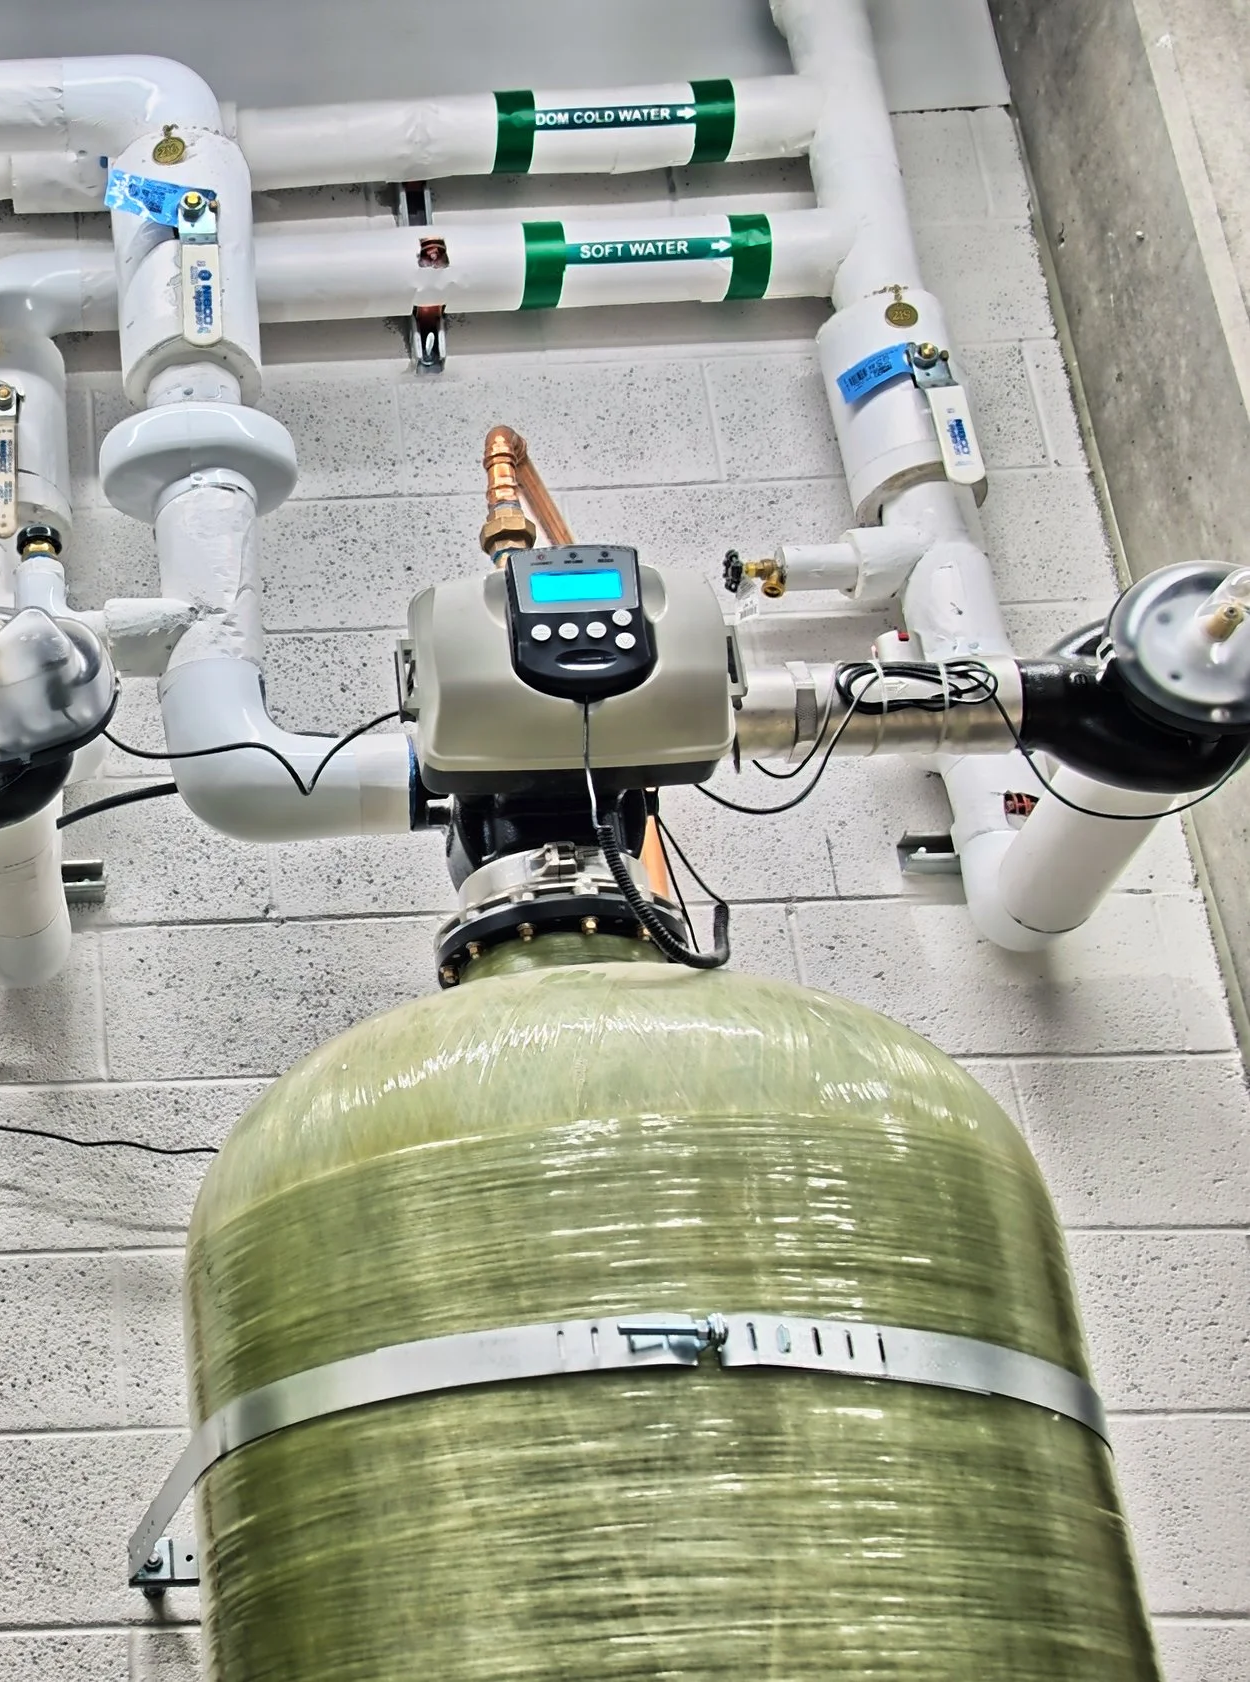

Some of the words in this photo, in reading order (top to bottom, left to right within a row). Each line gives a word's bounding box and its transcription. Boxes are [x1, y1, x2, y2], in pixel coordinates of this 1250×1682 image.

[535, 112, 569, 126] DOM
[573, 110, 614, 124] COLD
[618, 108, 671, 122] WATER
[580, 243, 623, 259] SOFT
[629, 241, 689, 257] WATER
